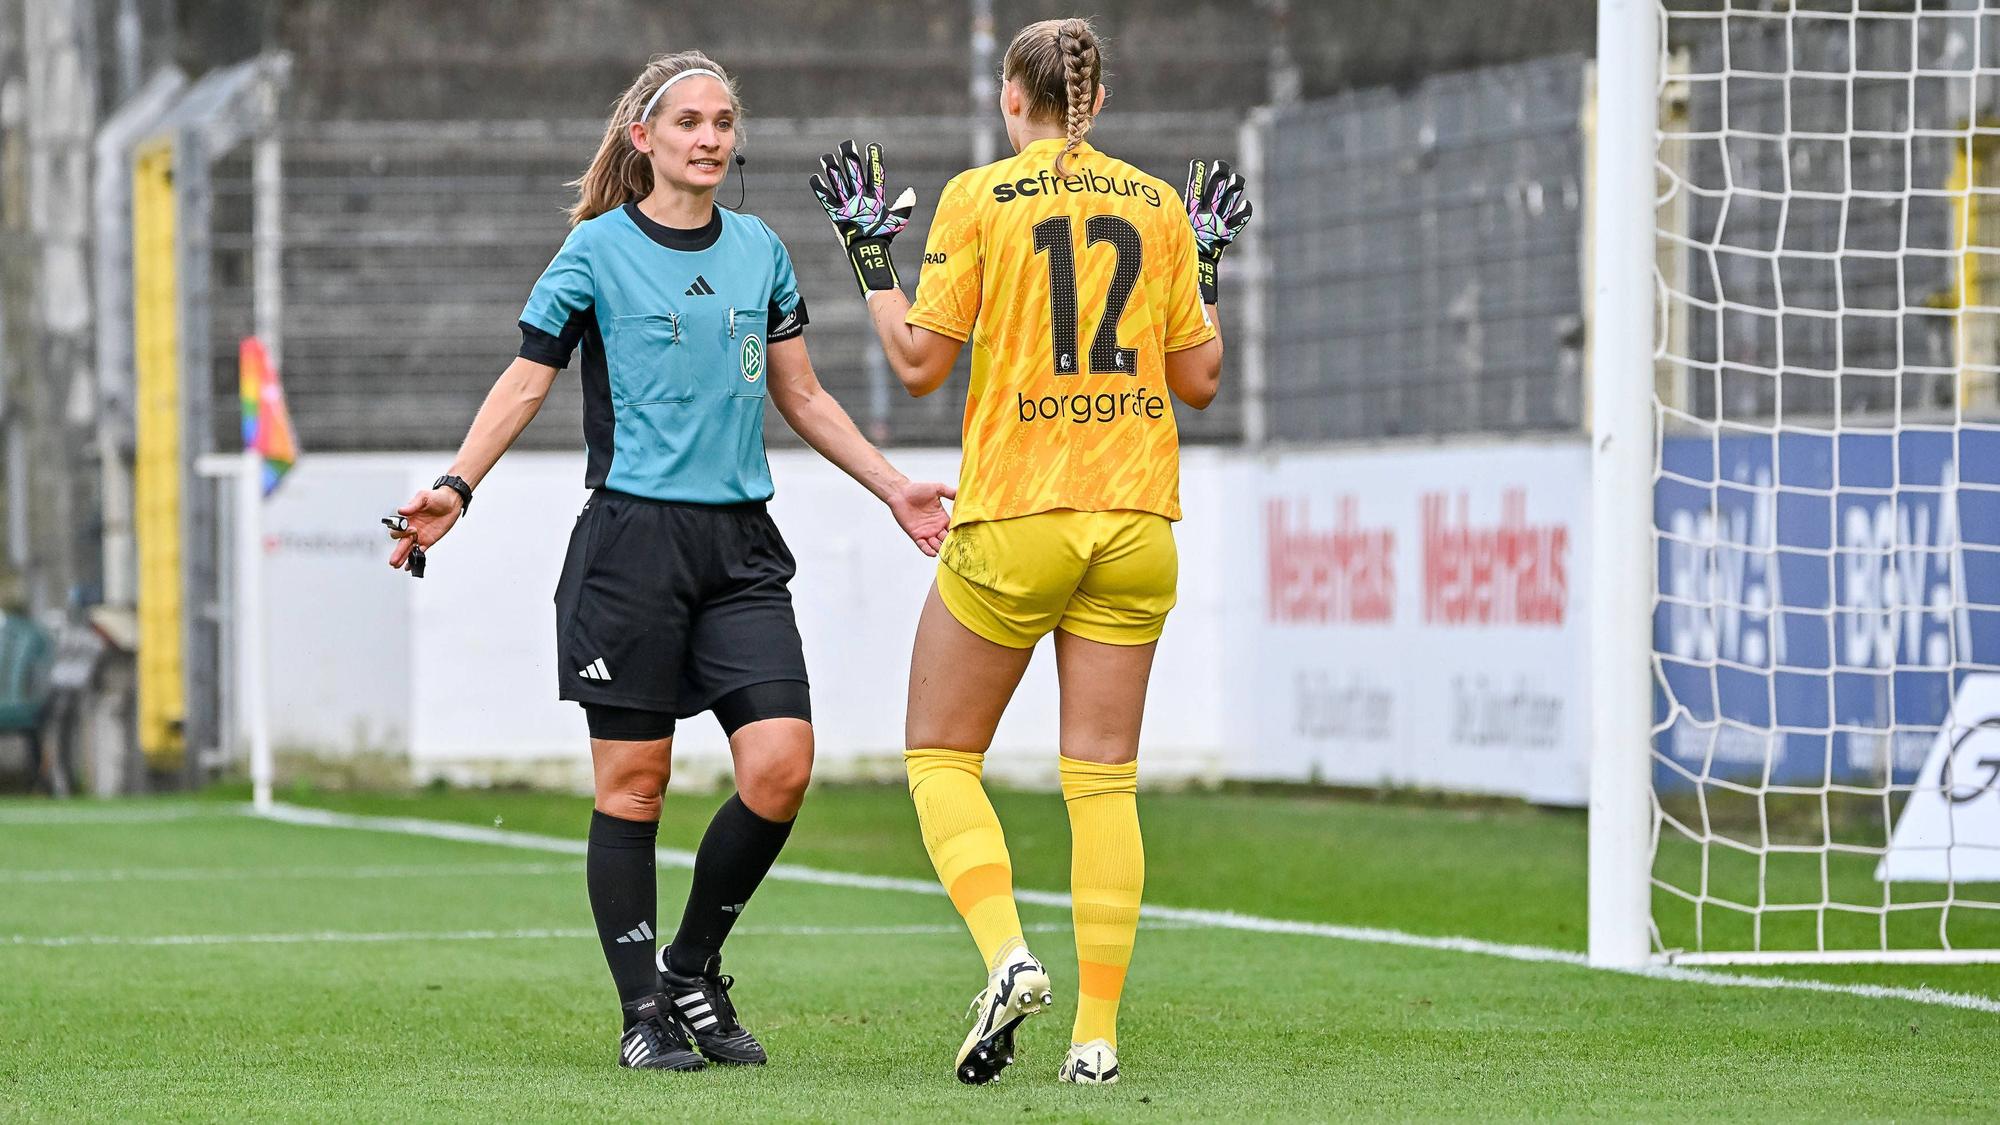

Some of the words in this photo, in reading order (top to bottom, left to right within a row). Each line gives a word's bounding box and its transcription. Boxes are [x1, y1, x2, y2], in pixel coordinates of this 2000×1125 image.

[870, 145, 884, 187] reusch
[1194, 161, 1205, 200] reusch
[859, 244, 882, 258] RB
[864, 257, 885, 270] 12
[1032, 214, 1143, 376] 12
